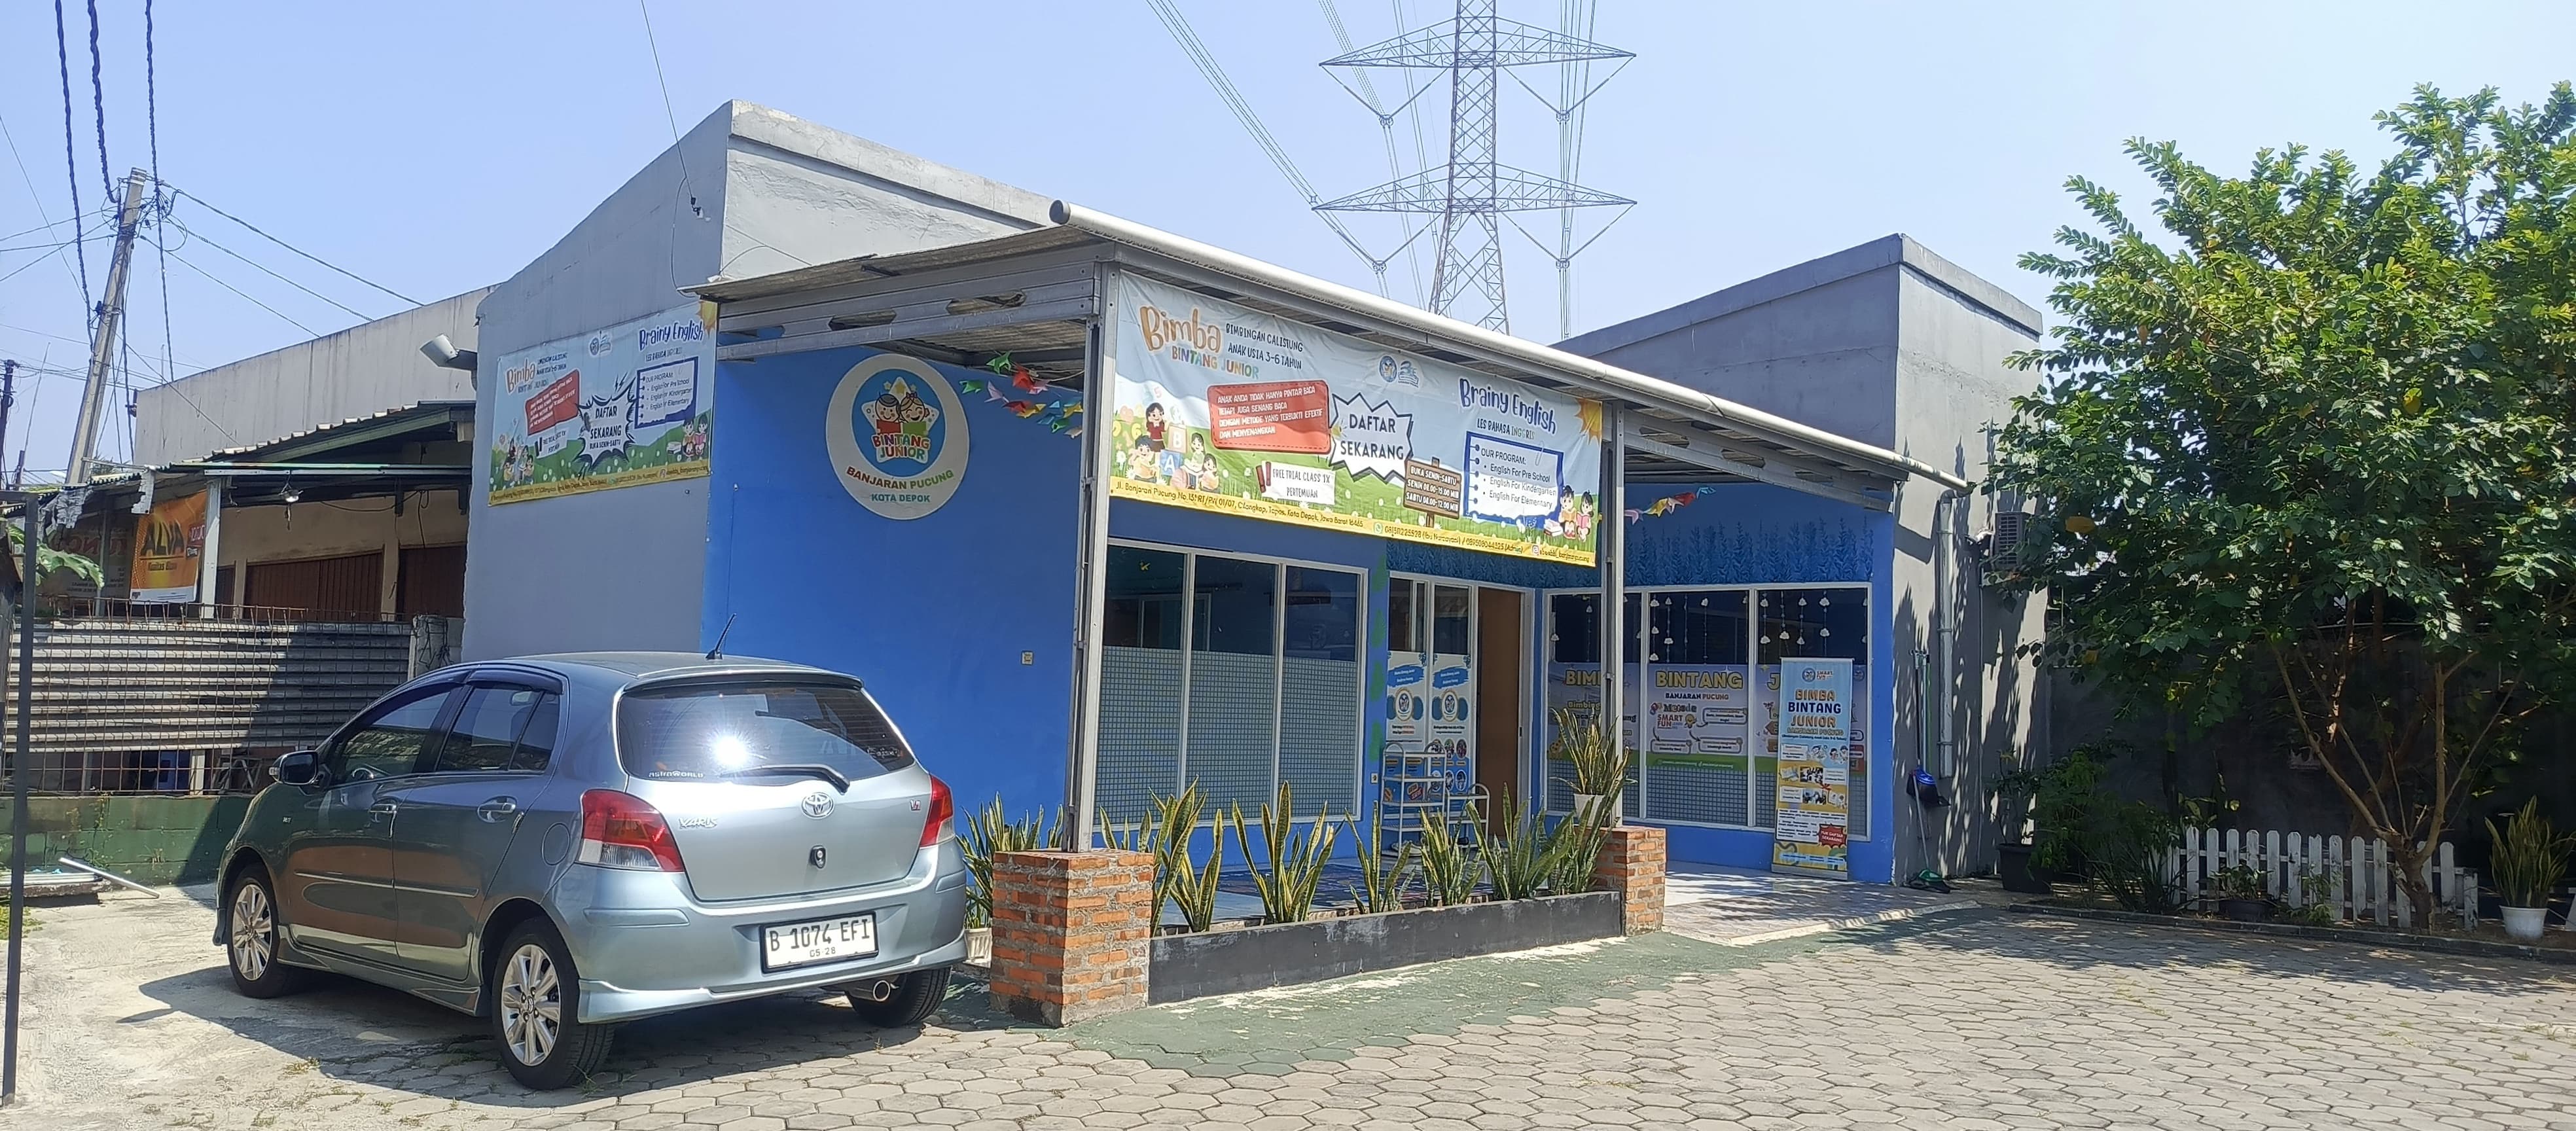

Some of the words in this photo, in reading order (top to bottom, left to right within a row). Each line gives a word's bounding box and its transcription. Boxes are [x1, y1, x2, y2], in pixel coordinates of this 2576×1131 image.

[639, 326, 671, 351] Brainy
[673, 320, 703, 341] English
[1139, 305, 1223, 353] Bimba
[1226, 323, 1265, 342] BIMBINGAN
[1267, 329, 1304, 352] CALISTUNG
[1172, 346, 1218, 371] BINTANG
[1221, 359, 1259, 380] JUNIOR
[1228, 342, 1247, 356] ANAK
[1247, 346, 1264, 361] USIA
[1265, 351, 1280, 365] 3-6
[1281, 354, 1302, 369] TAHUN
[507, 359, 535, 393] Bimba
[1218, 395, 1232, 403] ANAK
[1266, 391, 1282, 400] HANYA
[1284, 388, 1303, 397] PINTAR
[596, 406, 617, 419] DAFTAR
[1219, 406, 1235, 416] TETAPI
[1237, 406, 1249, 414] JUGA
[1251, 404, 1272, 412] SENANG
[1275, 402, 1287, 410] BACA
[1459, 378, 1508, 414] Brainy
[1512, 395, 1556, 434] English
[1219, 418, 1240, 427] DENGAN
[1242, 416, 1263, 425] METODE
[1264, 414, 1278, 423] YANG
[1280, 412, 1302, 421] TERBUKTI
[1305, 408, 1323, 418] EFEKTIF
[1350, 414, 1395, 433] DAFTAR
[590, 425, 622, 439] SEKARANG
[1219, 431, 1231, 439] DAN
[1232, 426, 1276, 437] MENYENANGKAN
[1477, 418, 1486, 429] LES
[1488, 421, 1510, 435] BAHASA
[1511, 427, 1535, 440] INGGRIS
[872, 434, 930, 448] BINTANG
[1341, 440, 1404, 459] SEKARANG
[880, 446, 925, 459] JUNIOR
[1481, 448, 1494, 458] OUR
[1495, 452, 1526, 465] PROGRAM:
[846, 466, 906, 489] BANJARAN
[910, 470, 954, 489] PUCUNG
[1272, 469, 1285, 479] FREE
[1285, 470, 1301, 480] TRIAL
[1303, 472, 1321, 482] CLASS
[1323, 475, 1330, 484] 1X
[1410, 465, 1424, 477] BUKA
[1425, 470, 1457, 486] SENIN-SABTU
[1490, 464, 1511, 475] English
[1512, 468, 1521, 476] For
[1522, 471, 1531, 479] Pre
[1533, 473, 1550, 482] School
[1125, 483, 1152, 495] Banjaran
[1153, 488, 1176, 501] Pucung
[1287, 487, 1318, 498] PERTEMUAN
[1407, 479, 1423, 489] SENIN
[1490, 477, 1511, 488] English
[1522, 483, 1556, 495] Kindergarten
[899, 494, 931, 503] DEPOK
[1406, 492, 1422, 503] SABTU
[1490, 490, 1510, 501] English
[1511, 494, 1520, 503] For
[1521, 496, 1552, 509] Elementary
[1656, 670, 1744, 689] BINTANG
[1795, 689, 1835, 701] BIMBA
[1664, 703, 1696, 712] Metode
[1788, 702, 1841, 714] BINTANG
[1791, 715, 1836, 728] JUNIOR
[769, 930, 780, 951] B
[789, 924, 832, 949] 1074
[840, 919, 870, 942] EFI
